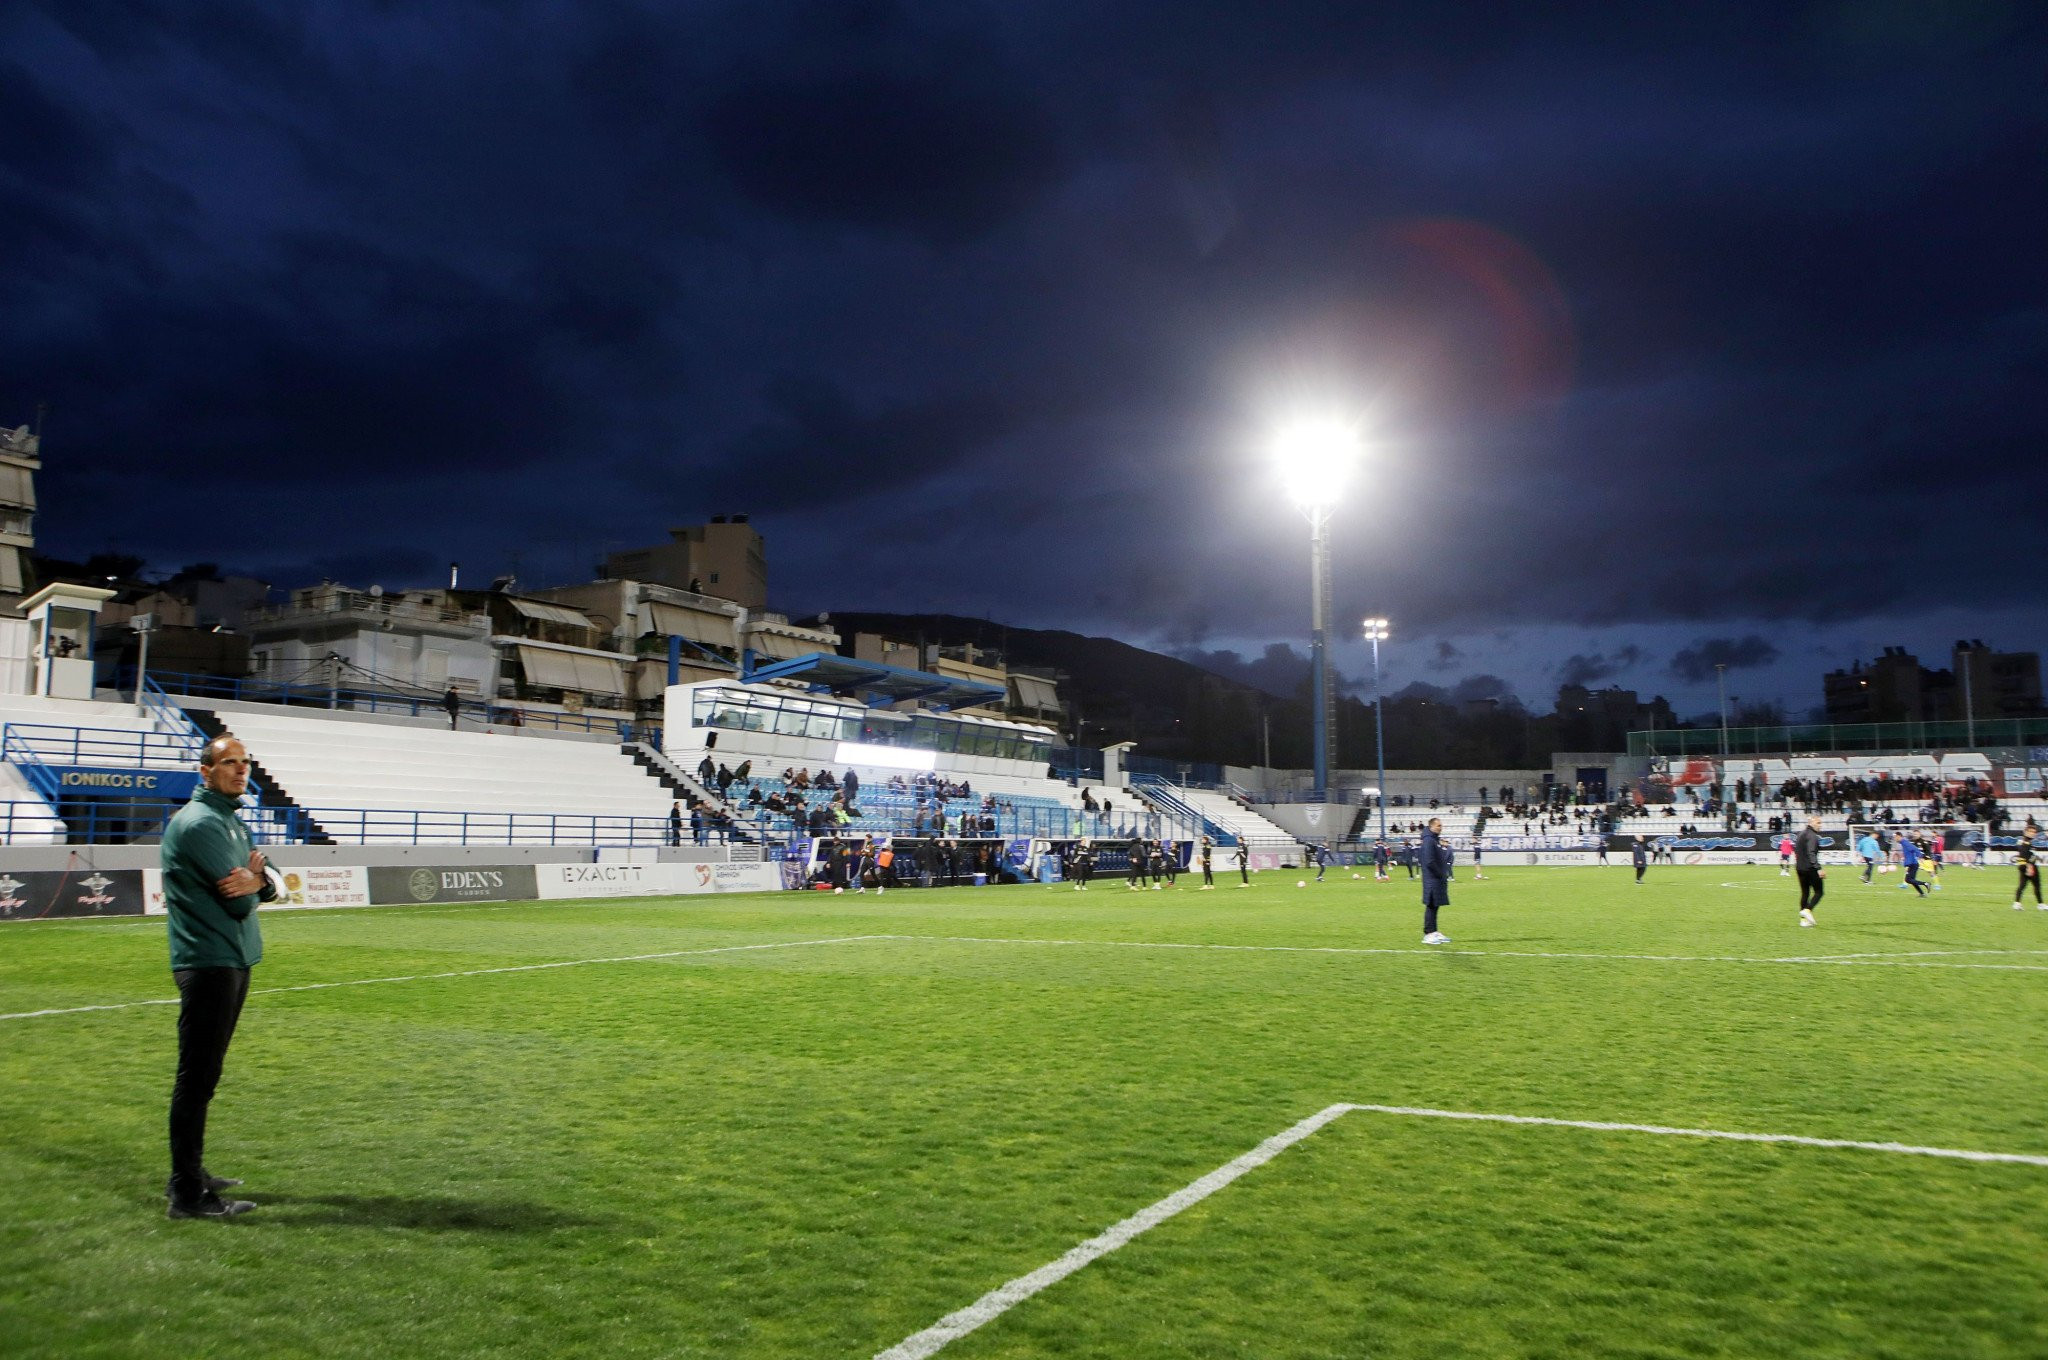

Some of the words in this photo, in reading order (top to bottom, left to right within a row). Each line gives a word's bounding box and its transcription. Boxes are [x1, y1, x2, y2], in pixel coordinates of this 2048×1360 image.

[61, 772, 132, 788] IONIKOS
[136, 775, 158, 789] FC
[441, 871, 504, 889] EDEN'S
[562, 866, 642, 882] EXACTT
